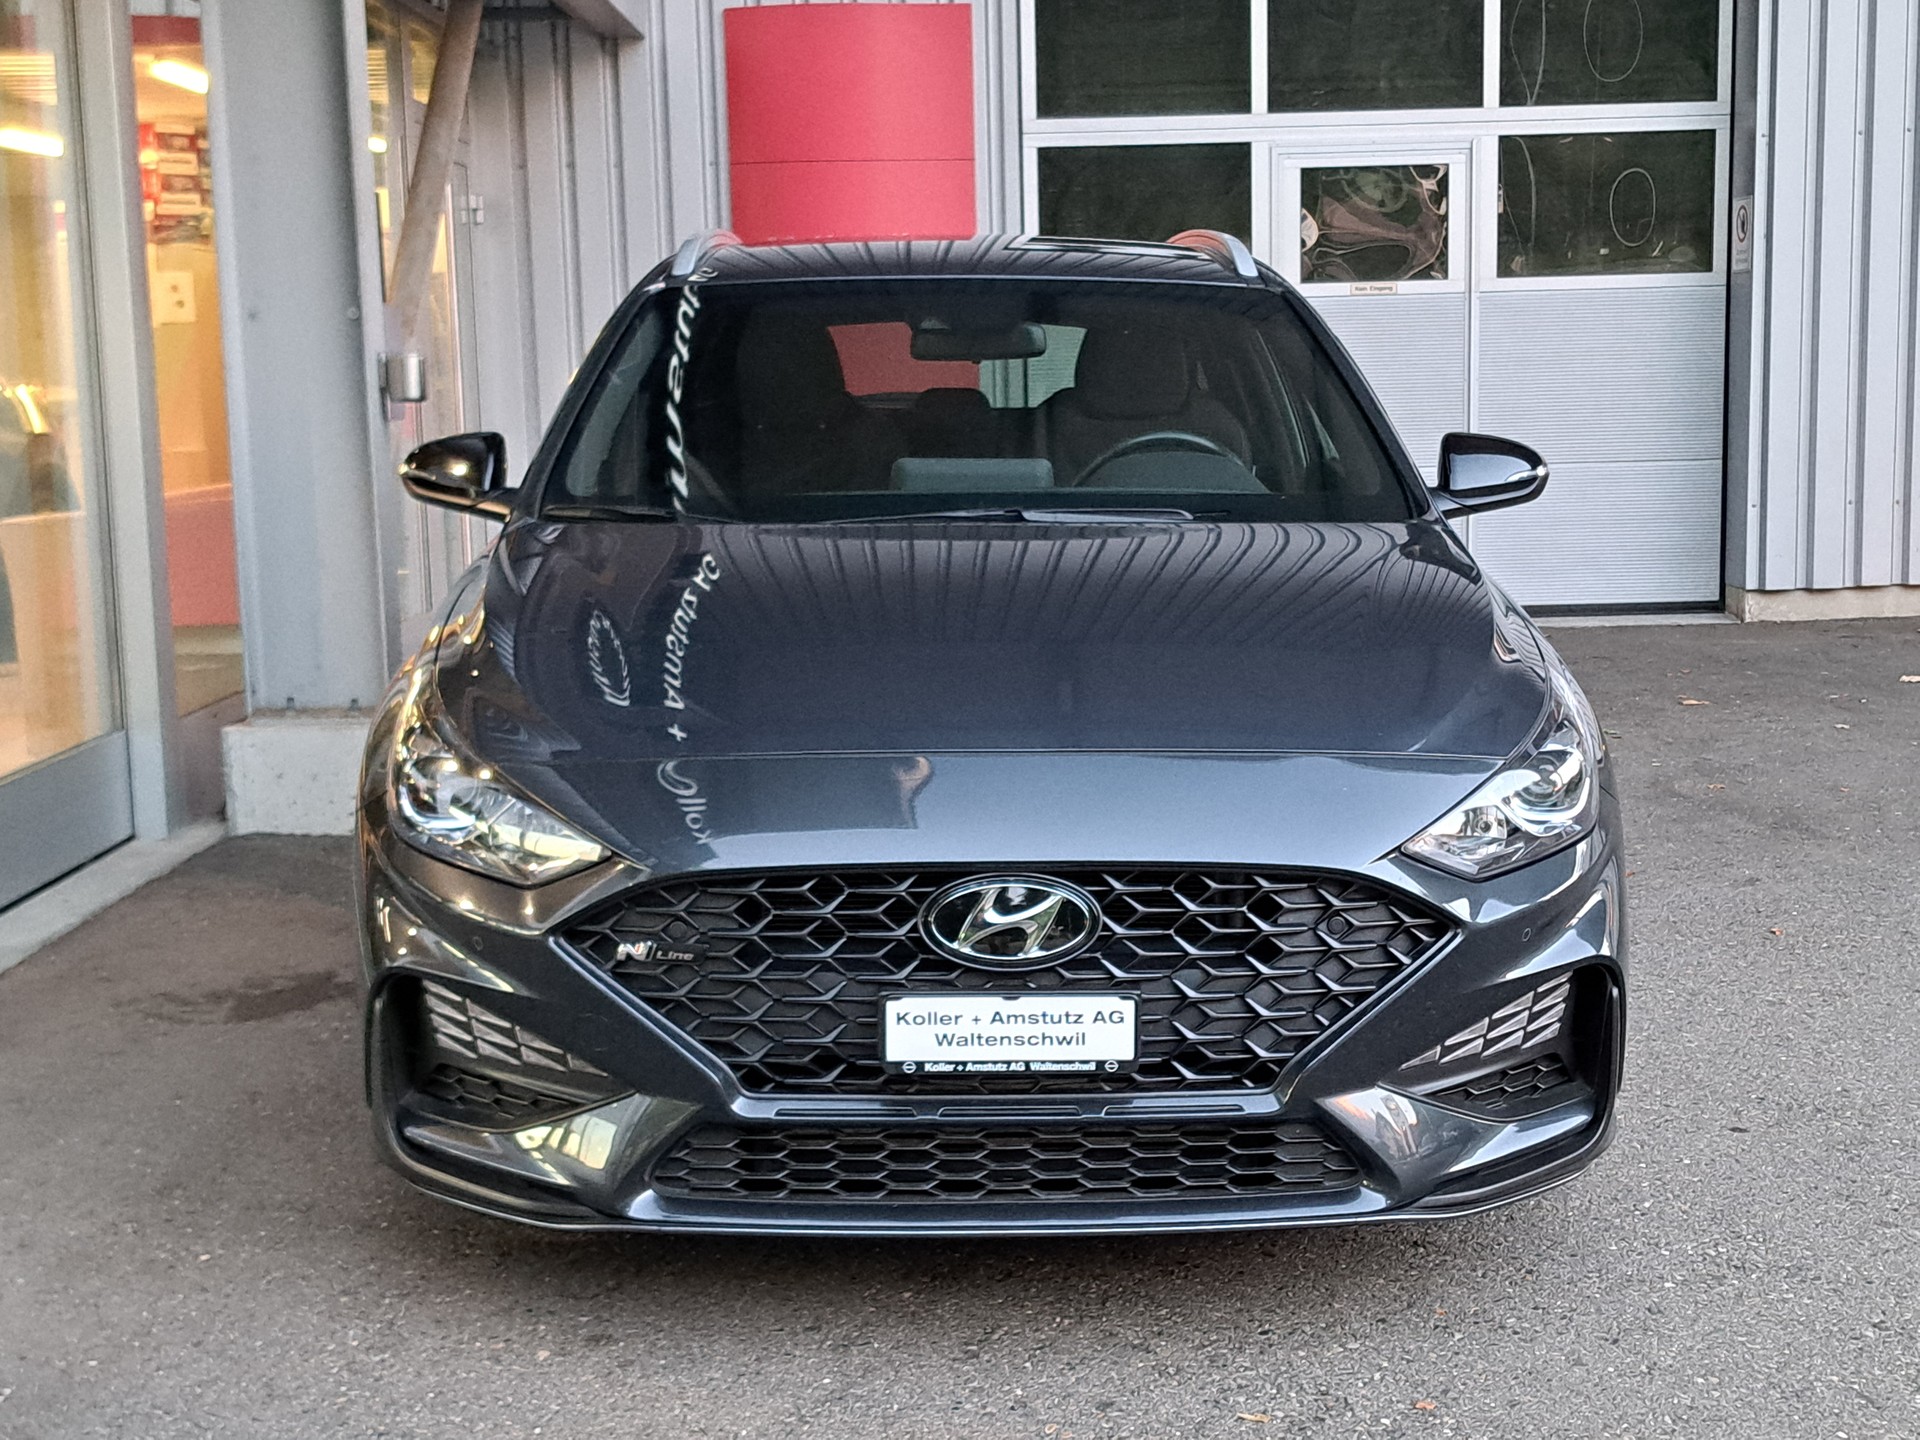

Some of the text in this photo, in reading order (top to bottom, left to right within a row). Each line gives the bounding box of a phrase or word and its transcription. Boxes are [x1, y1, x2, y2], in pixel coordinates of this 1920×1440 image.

[656, 950, 695, 961] Line
[896, 1010, 1125, 1026] Koller + Amstutz AG
[934, 1031, 1086, 1047] Waltenschwil
[924, 1063, 956, 1072] Koller
[965, 1062, 1008, 1072] Amstutz
[1008, 1062, 1026, 1071] AG
[1029, 1061, 1097, 1072] Waltenschwil
